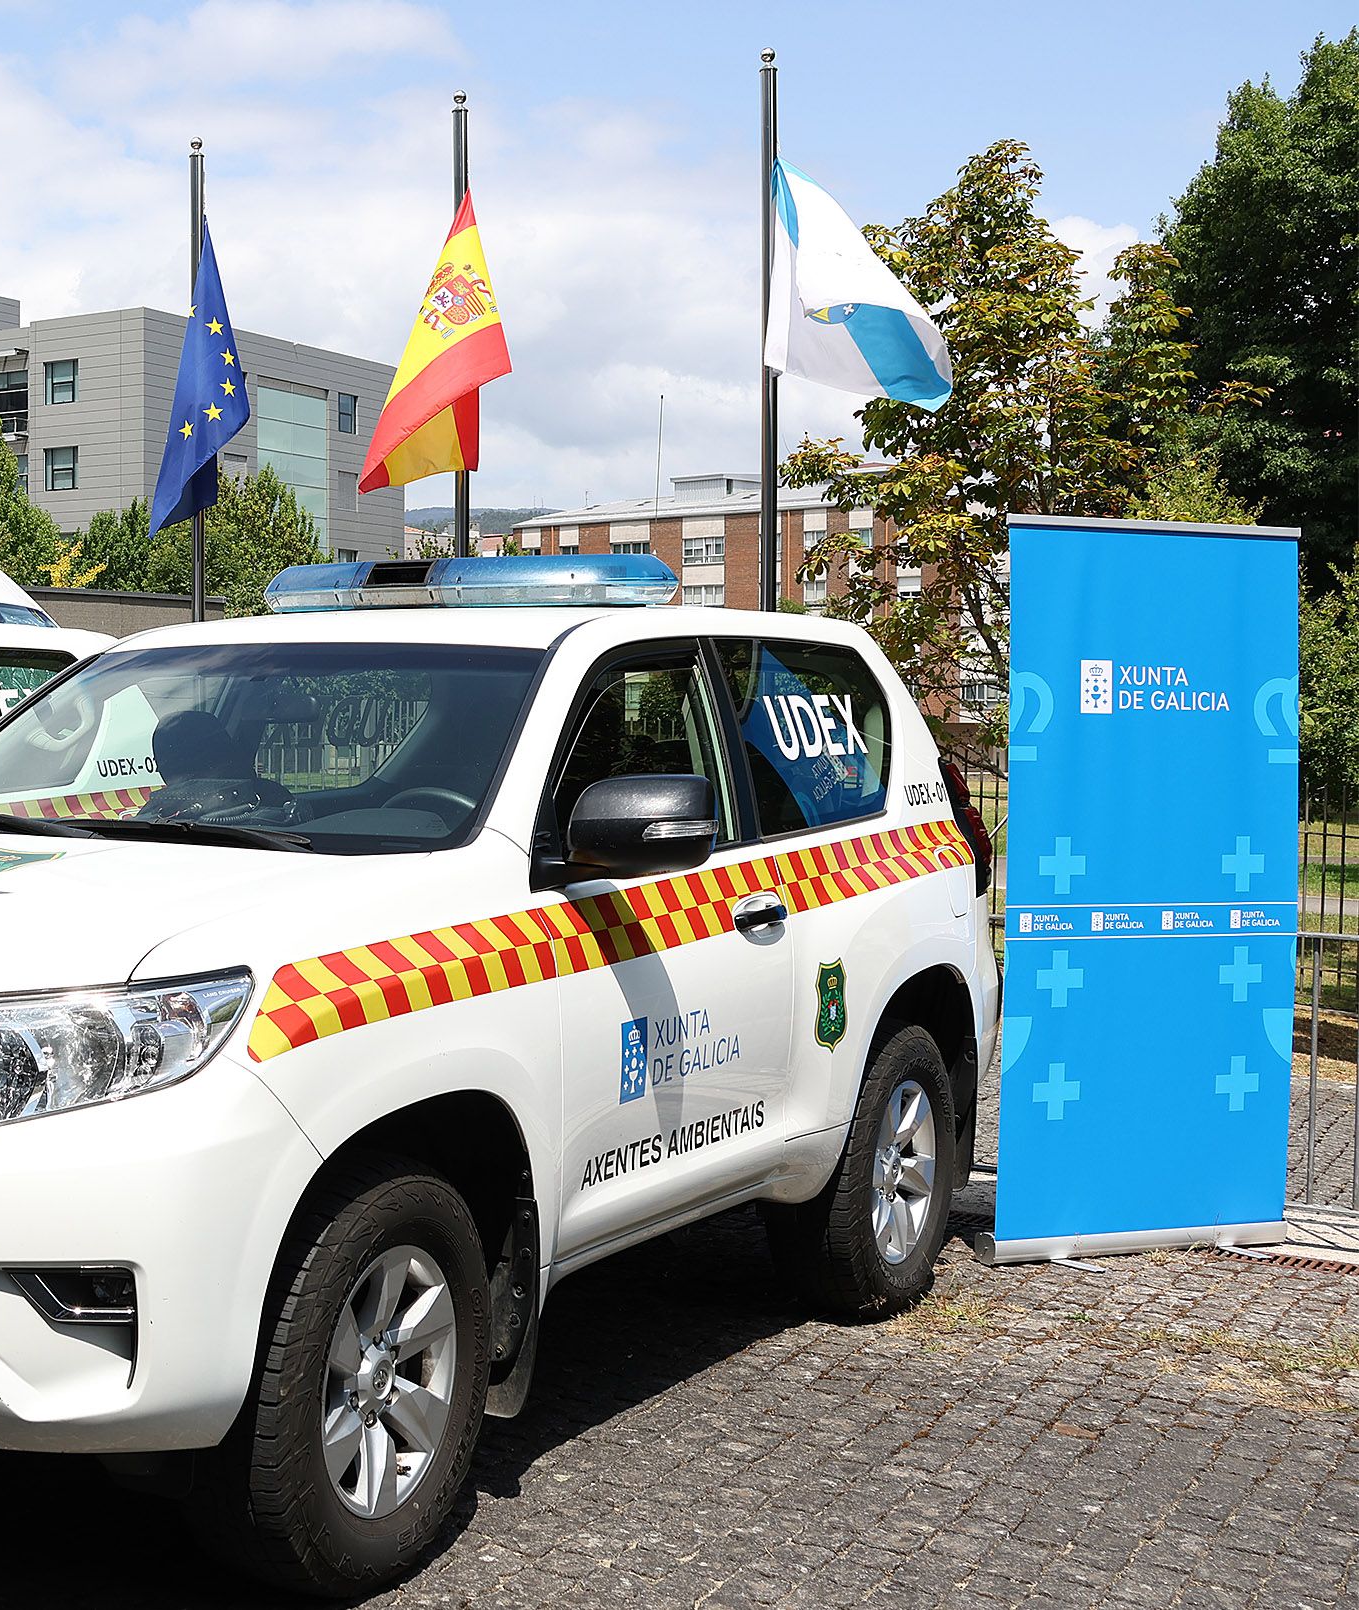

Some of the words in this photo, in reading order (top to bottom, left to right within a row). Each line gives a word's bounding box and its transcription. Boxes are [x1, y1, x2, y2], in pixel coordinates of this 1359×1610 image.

[1119, 665, 1189, 686] XUNTA
[1119, 690, 1144, 710] DE
[1150, 690, 1230, 712] GALICIA
[763, 694, 869, 761] UDEX
[903, 781, 948, 807] UDEX-01
[1033, 914, 1059, 922] XUNTA
[1105, 913, 1129, 921] XUNTA
[1115, 921, 1144, 929] GALICIA
[1185, 920, 1214, 928] GALICIA
[1242, 919, 1251, 927] DE
[654, 1008, 711, 1049] XUNTA
[652, 1054, 674, 1086] DE
[679, 1034, 740, 1078] GALICIA
[580, 1132, 663, 1191] AXENTES
[667, 1100, 765, 1159] AMBIENTAIS
